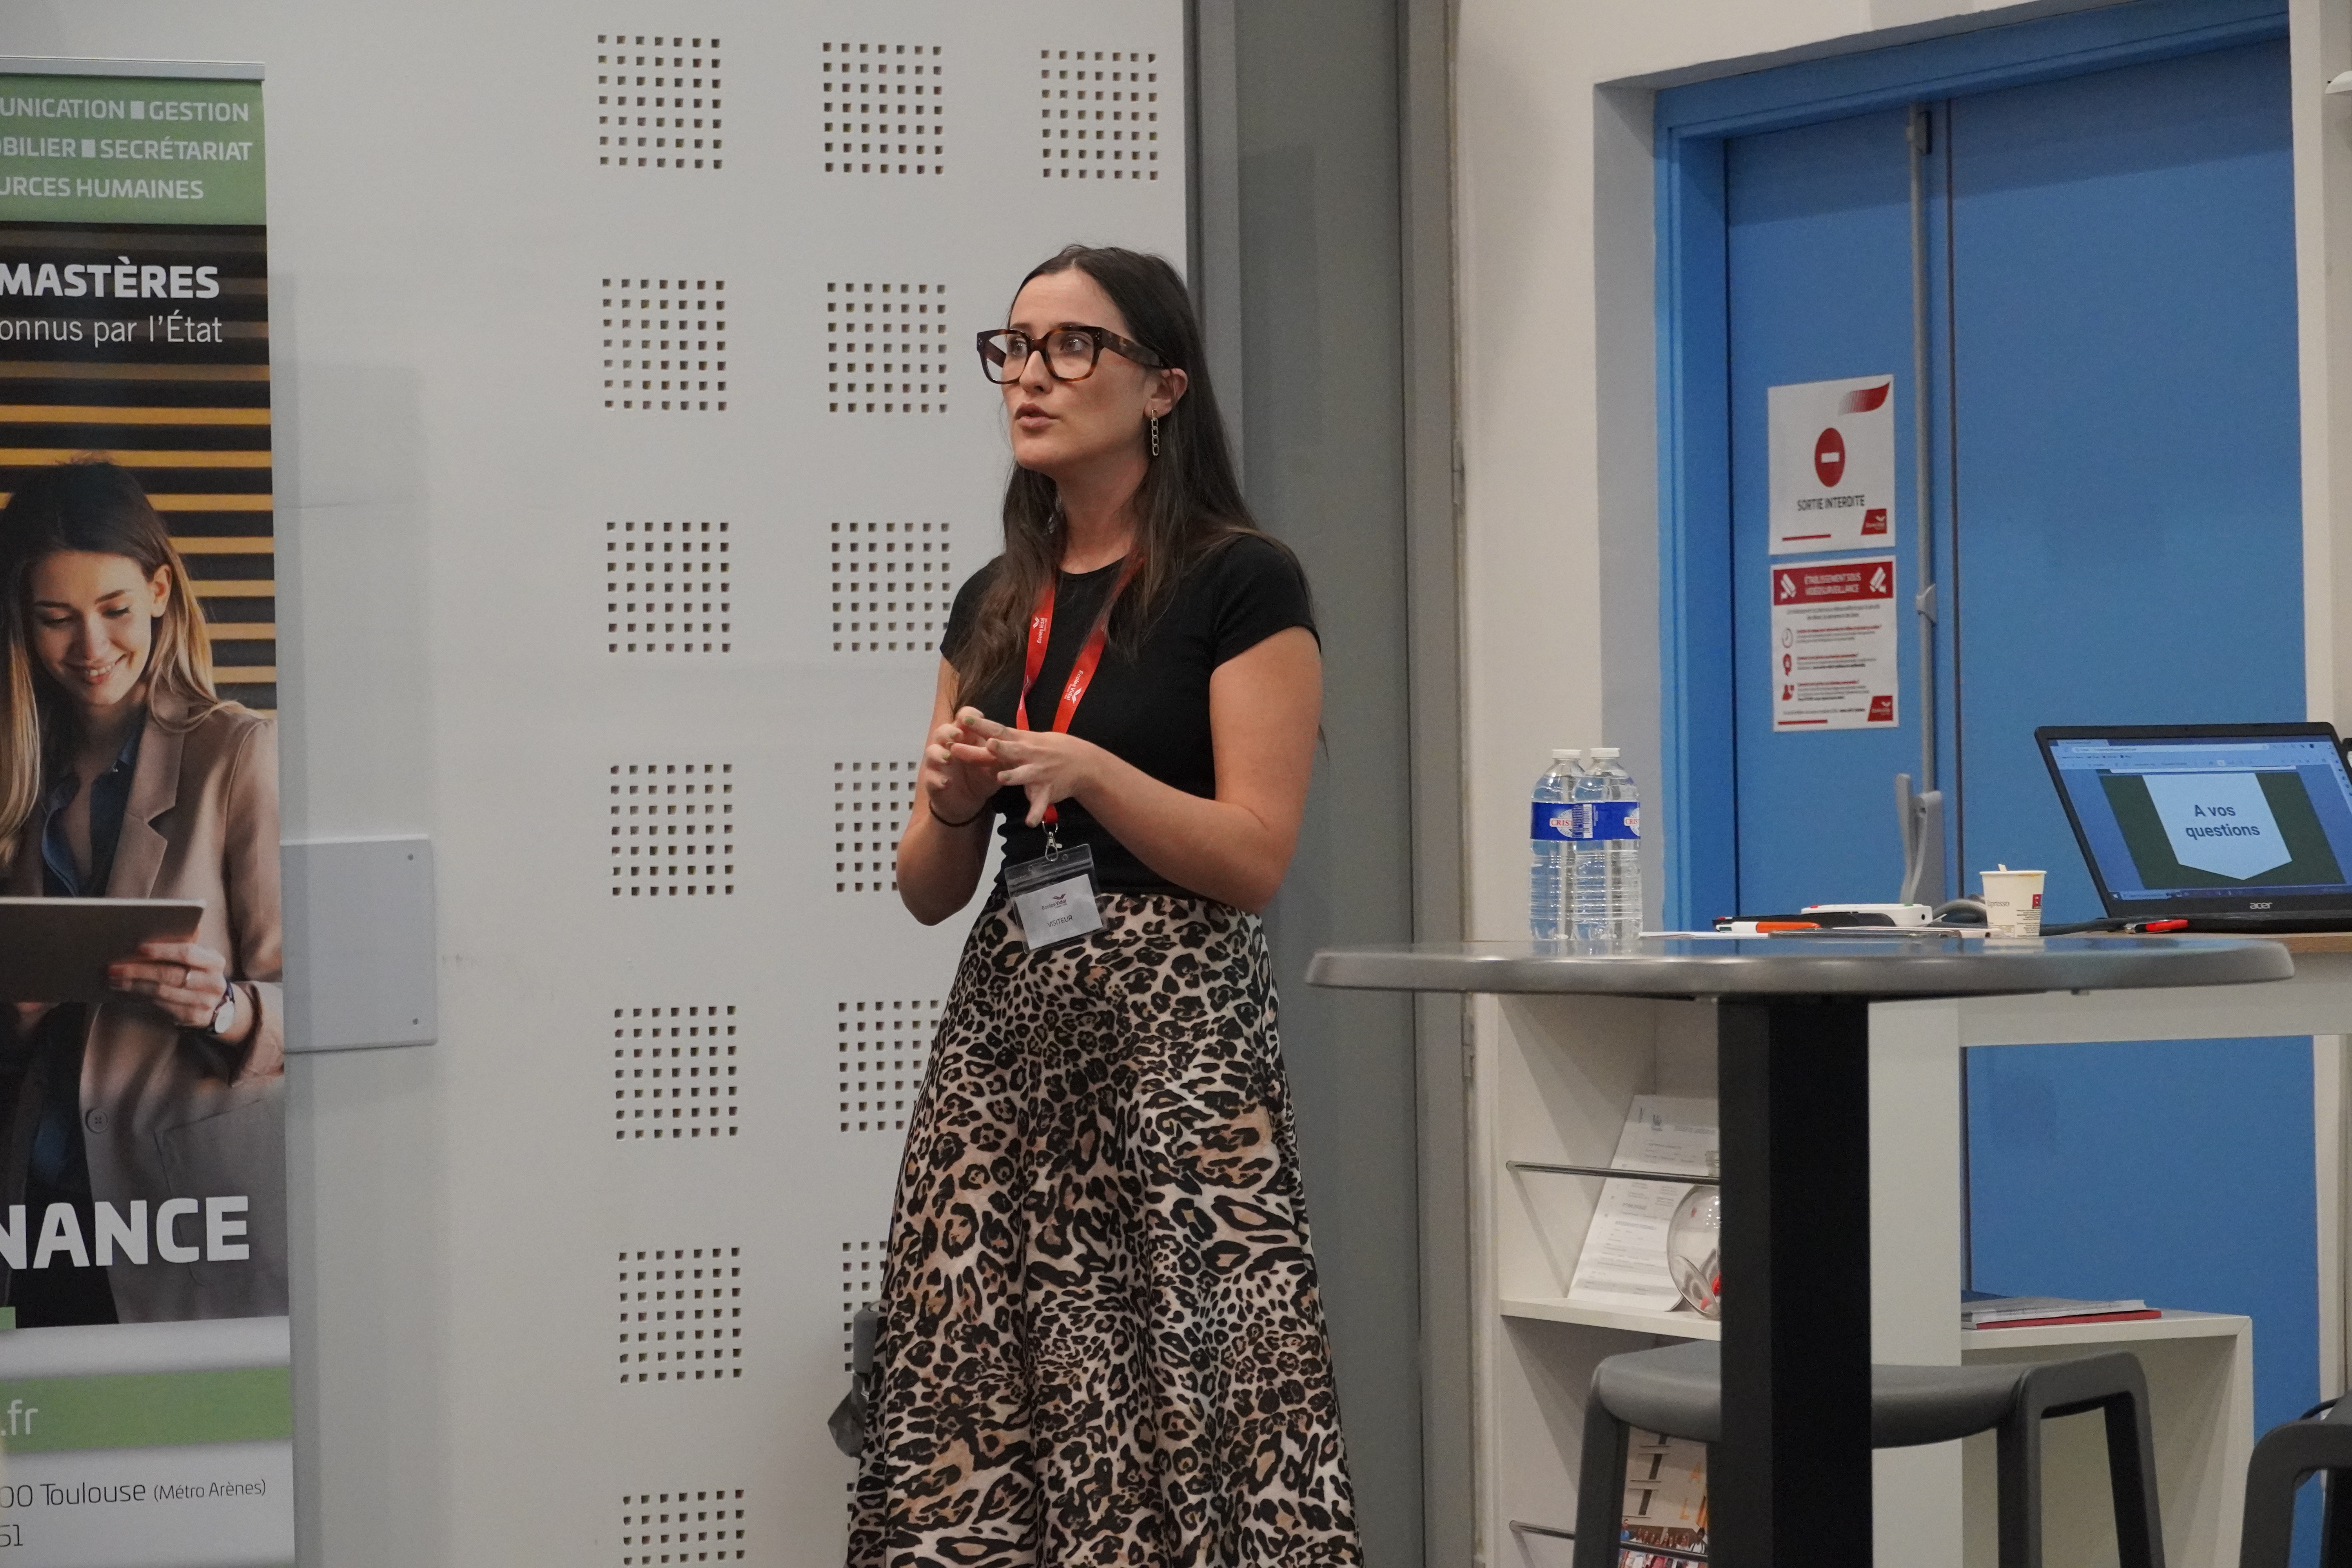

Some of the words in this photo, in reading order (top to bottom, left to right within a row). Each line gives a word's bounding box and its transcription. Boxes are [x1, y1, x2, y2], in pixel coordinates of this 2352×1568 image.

[0, 97, 125, 119] UNICATION
[149, 101, 249, 122] GESTION
[0, 137, 76, 157] BILIER
[100, 136, 253, 161] SECRÉTARIAT
[77, 179, 204, 199] HUMAINES
[0, 256, 220, 299] MASTÈRES
[0, 320, 83, 341] onnus
[94, 321, 137, 348] par
[149, 309, 223, 343] l’État
[1072, 670, 1084, 687] Ecoles
[1066, 688, 1076, 701] Vidal
[2195, 804, 2207, 817] A
[2207, 806, 2236, 816] vos
[2186, 823, 2260, 840] questions
[1047, 915, 1073, 927] VISITEUR
[40, 1481, 146, 1506] Toulouse
[154, 1485, 205, 1502] (Métro
[209, 1479, 266, 1497] Arènes)
